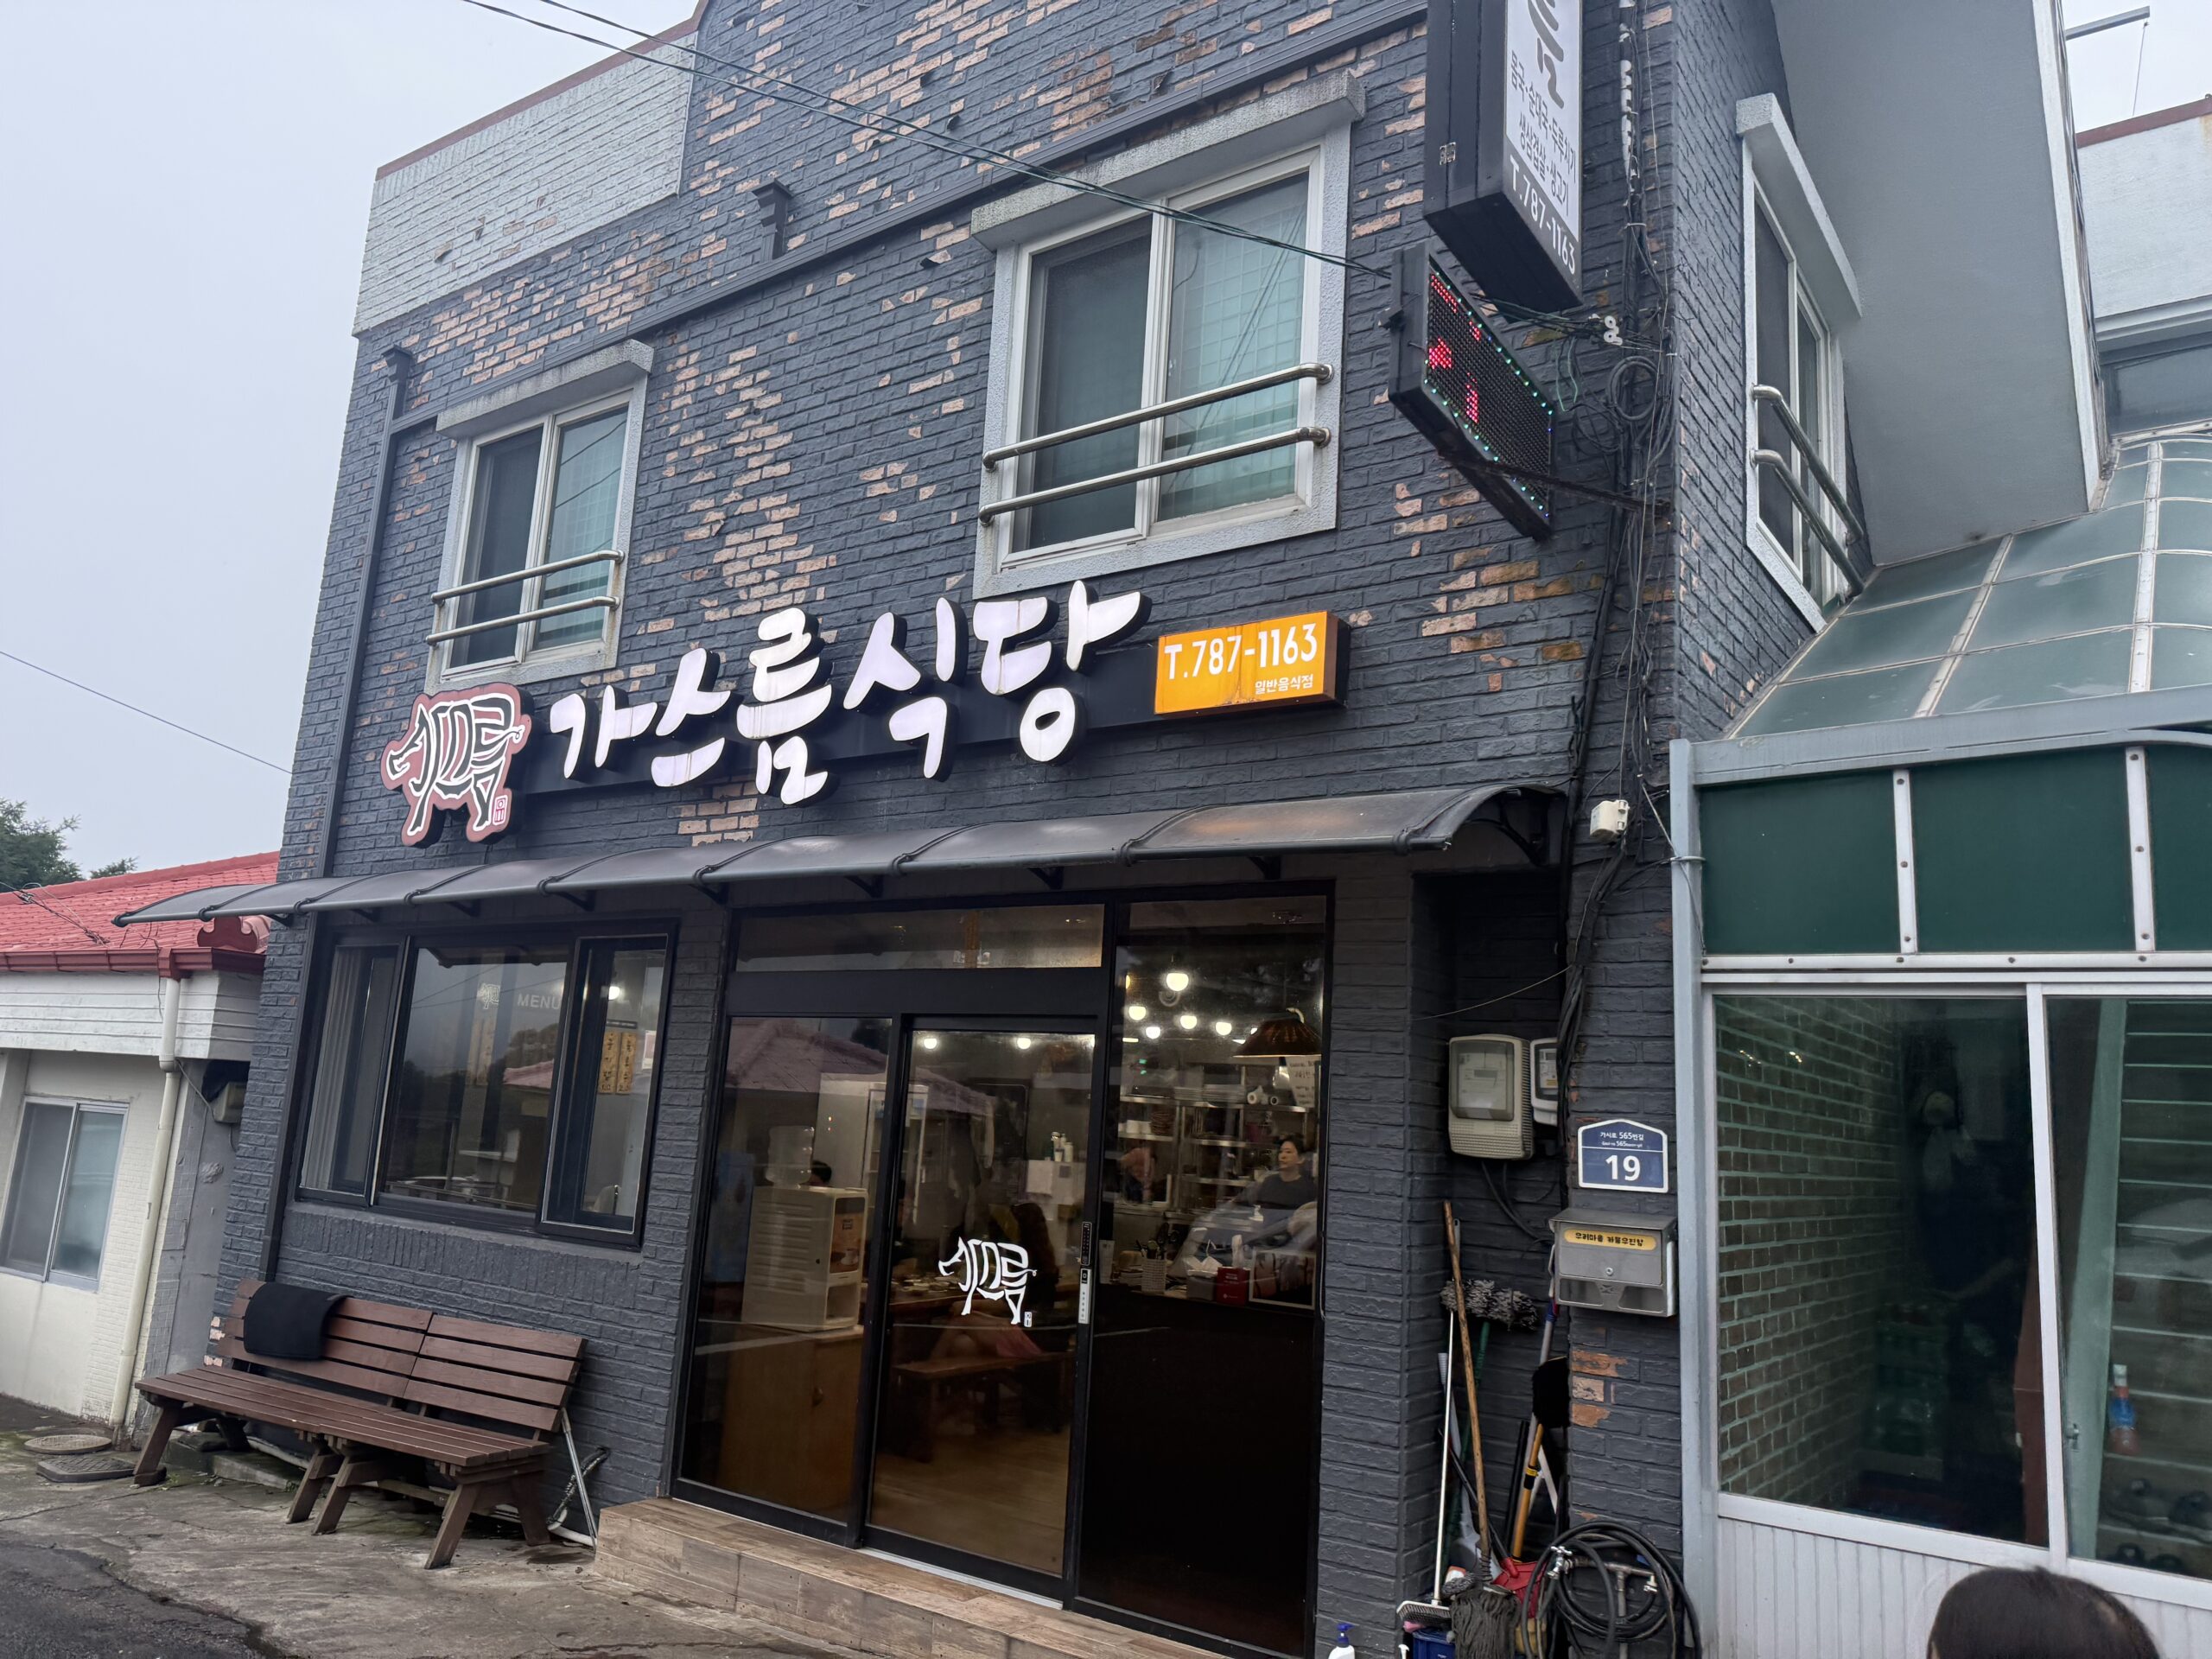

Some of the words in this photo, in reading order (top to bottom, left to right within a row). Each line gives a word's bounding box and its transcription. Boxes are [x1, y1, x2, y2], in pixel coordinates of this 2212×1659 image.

[1519, 111, 1569, 217] 생삼겹살·생고기
[1510, 155, 1576, 276] T.787-1163
[1164, 622, 1318, 680] T.787-1163
[550, 580, 1141, 806] 가스름식당
[1255, 674, 1314, 696] 일반음식점
[518, 993, 563, 1010] MENU
[1605, 1154, 1641, 1181] 19
[1575, 1232, 1604, 1243] 우리마을
